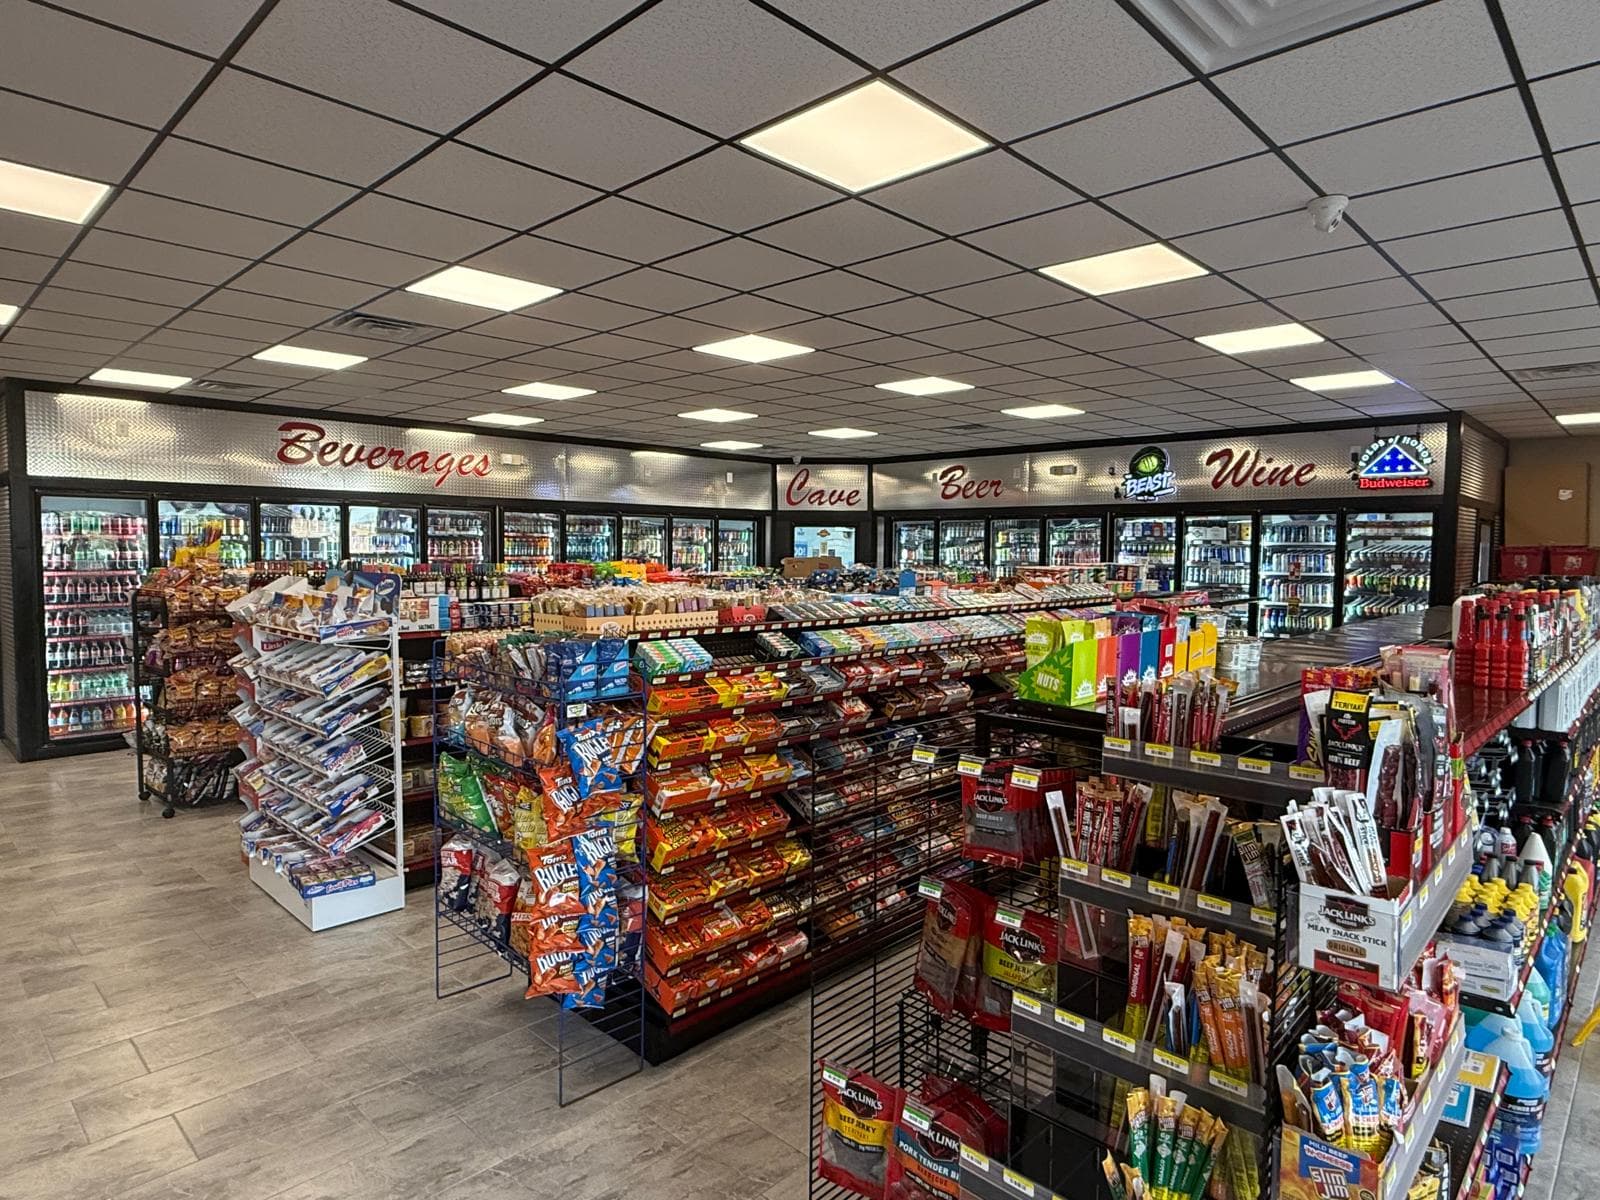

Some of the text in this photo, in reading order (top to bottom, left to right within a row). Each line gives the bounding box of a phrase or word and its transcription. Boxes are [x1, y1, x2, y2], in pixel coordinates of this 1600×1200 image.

[277, 421, 493, 488] Beverages
[1401, 435, 1433, 465] HONOR
[1206, 447, 1317, 490] Wine
[786, 468, 861, 507] Cave
[938, 464, 1004, 501] Beer
[1125, 471, 1174, 497] BEAST
[1359, 477, 1429, 489] Budweiser
[1036, 671, 1061, 692] NUTS
[571, 736, 608, 766] BUGLE
[1318, 905, 1344, 920] JACK
[999, 930, 1020, 946] JACK
[1307, 922, 1331, 934] MEAT
[1332, 927, 1361, 942] SNACK
[1361, 935, 1388, 948] STICK
[1328, 941, 1364, 957] ORIGINAL
[999, 958, 1014, 969] BEEF
[839, 1113, 877, 1134] BEEF JERKY
[898, 1139, 919, 1159] PORK
[918, 1153, 950, 1177] TENDER
[1308, 1139, 1349, 1160] MILD BEEF
